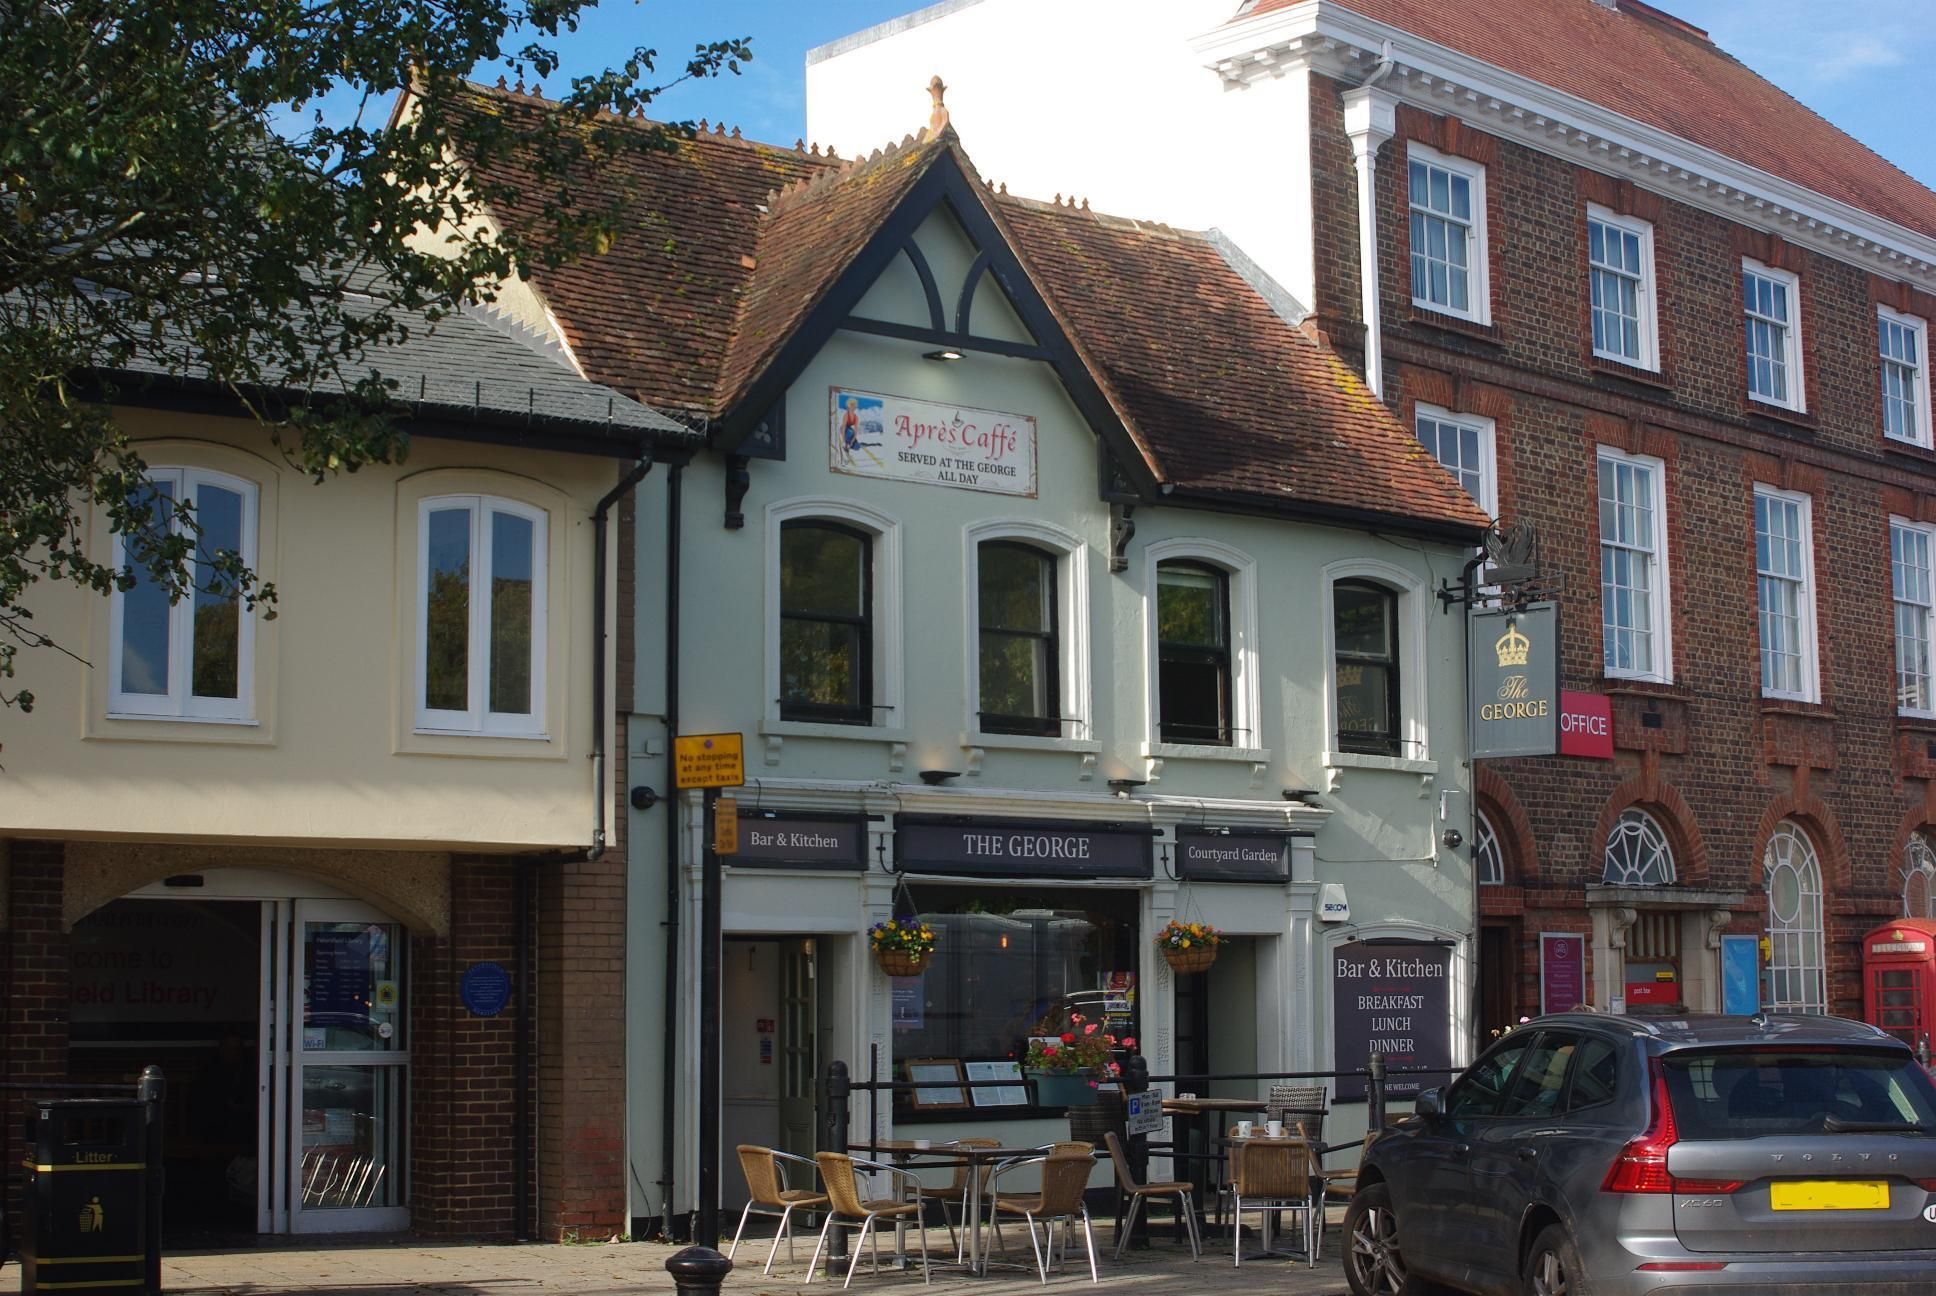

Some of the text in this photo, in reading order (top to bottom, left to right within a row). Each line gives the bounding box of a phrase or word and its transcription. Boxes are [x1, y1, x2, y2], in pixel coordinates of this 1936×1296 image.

[894, 414, 956, 449] Après
[898, 451, 1017, 477] SERVED AT THE GEORGE
[937, 470, 979, 486] ALL DAY
[1496, 675, 1529, 701] The
[1480, 700, 1548, 721] GEORGE
[1560, 712, 1608, 736] OFFICE
[680, 751, 739, 763] No stopping
[682, 762, 737, 773] at any time
[681, 772, 739, 785] except taxis
[751, 831, 774, 846] Bar
[776, 832, 787, 846] &
[790, 833, 839, 848] Kitchen
[963, 834, 1090, 859] THE GEORGE
[1188, 846, 1277, 862] Courtyard Garden
[1325, 903, 1347, 911] SECOM
[1336, 958, 1443, 978] Bar & Kitchen
[125, 979, 217, 1010] Library
[1357, 995, 1425, 1010] BREAKFAST
[1371, 1016, 1412, 1031] LUNCH
[1369, 1038, 1416, 1053] DINNER
[1392, 1082, 1420, 1091] WELCOME
[75, 1151, 113, 1164] Litter
[1771, 1153, 1898, 1162] VOLVO
[1680, 1199, 1723, 1208] XC60
